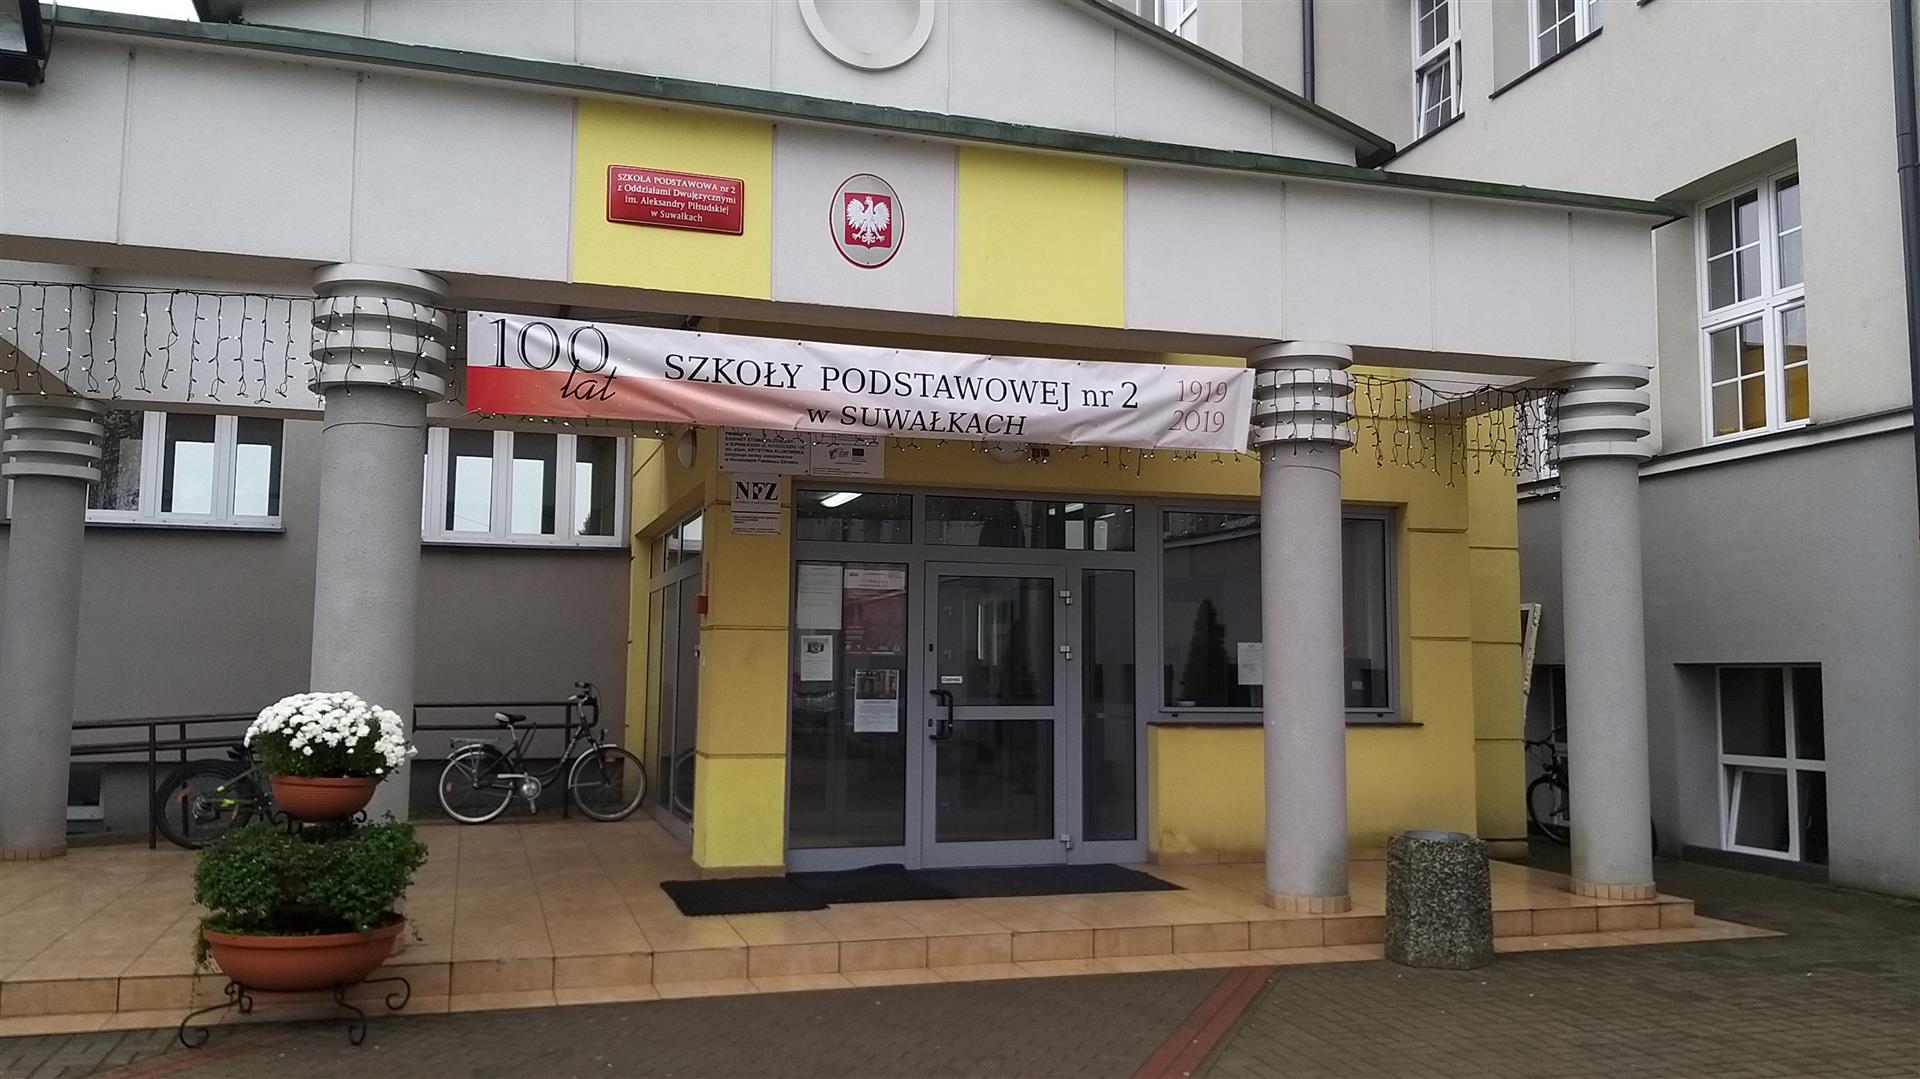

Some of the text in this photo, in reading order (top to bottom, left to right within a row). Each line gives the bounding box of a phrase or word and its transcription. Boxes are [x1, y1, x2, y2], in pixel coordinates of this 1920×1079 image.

[617, 173, 651, 183] SZKOŁA
[653, 176, 718, 191] PODSTAWOWA
[730, 186, 736, 194] 2
[624, 184, 671, 196] Oddziałami
[673, 188, 736, 204] Dwujęzycznymi
[640, 196, 685, 209] Aleksandry
[688, 201, 729, 215] Piłsudskiej
[488, 317, 609, 373] 100
[560, 359, 618, 401] lat
[664, 354, 1139, 411] SZKOŁY PODSTAWOWEJ nr 2
[1176, 380, 1229, 403] 1919
[807, 406, 1028, 436] w SUWAŁKACH
[1168, 409, 1226, 433] 2019
[735, 481, 779, 501] NFZ
